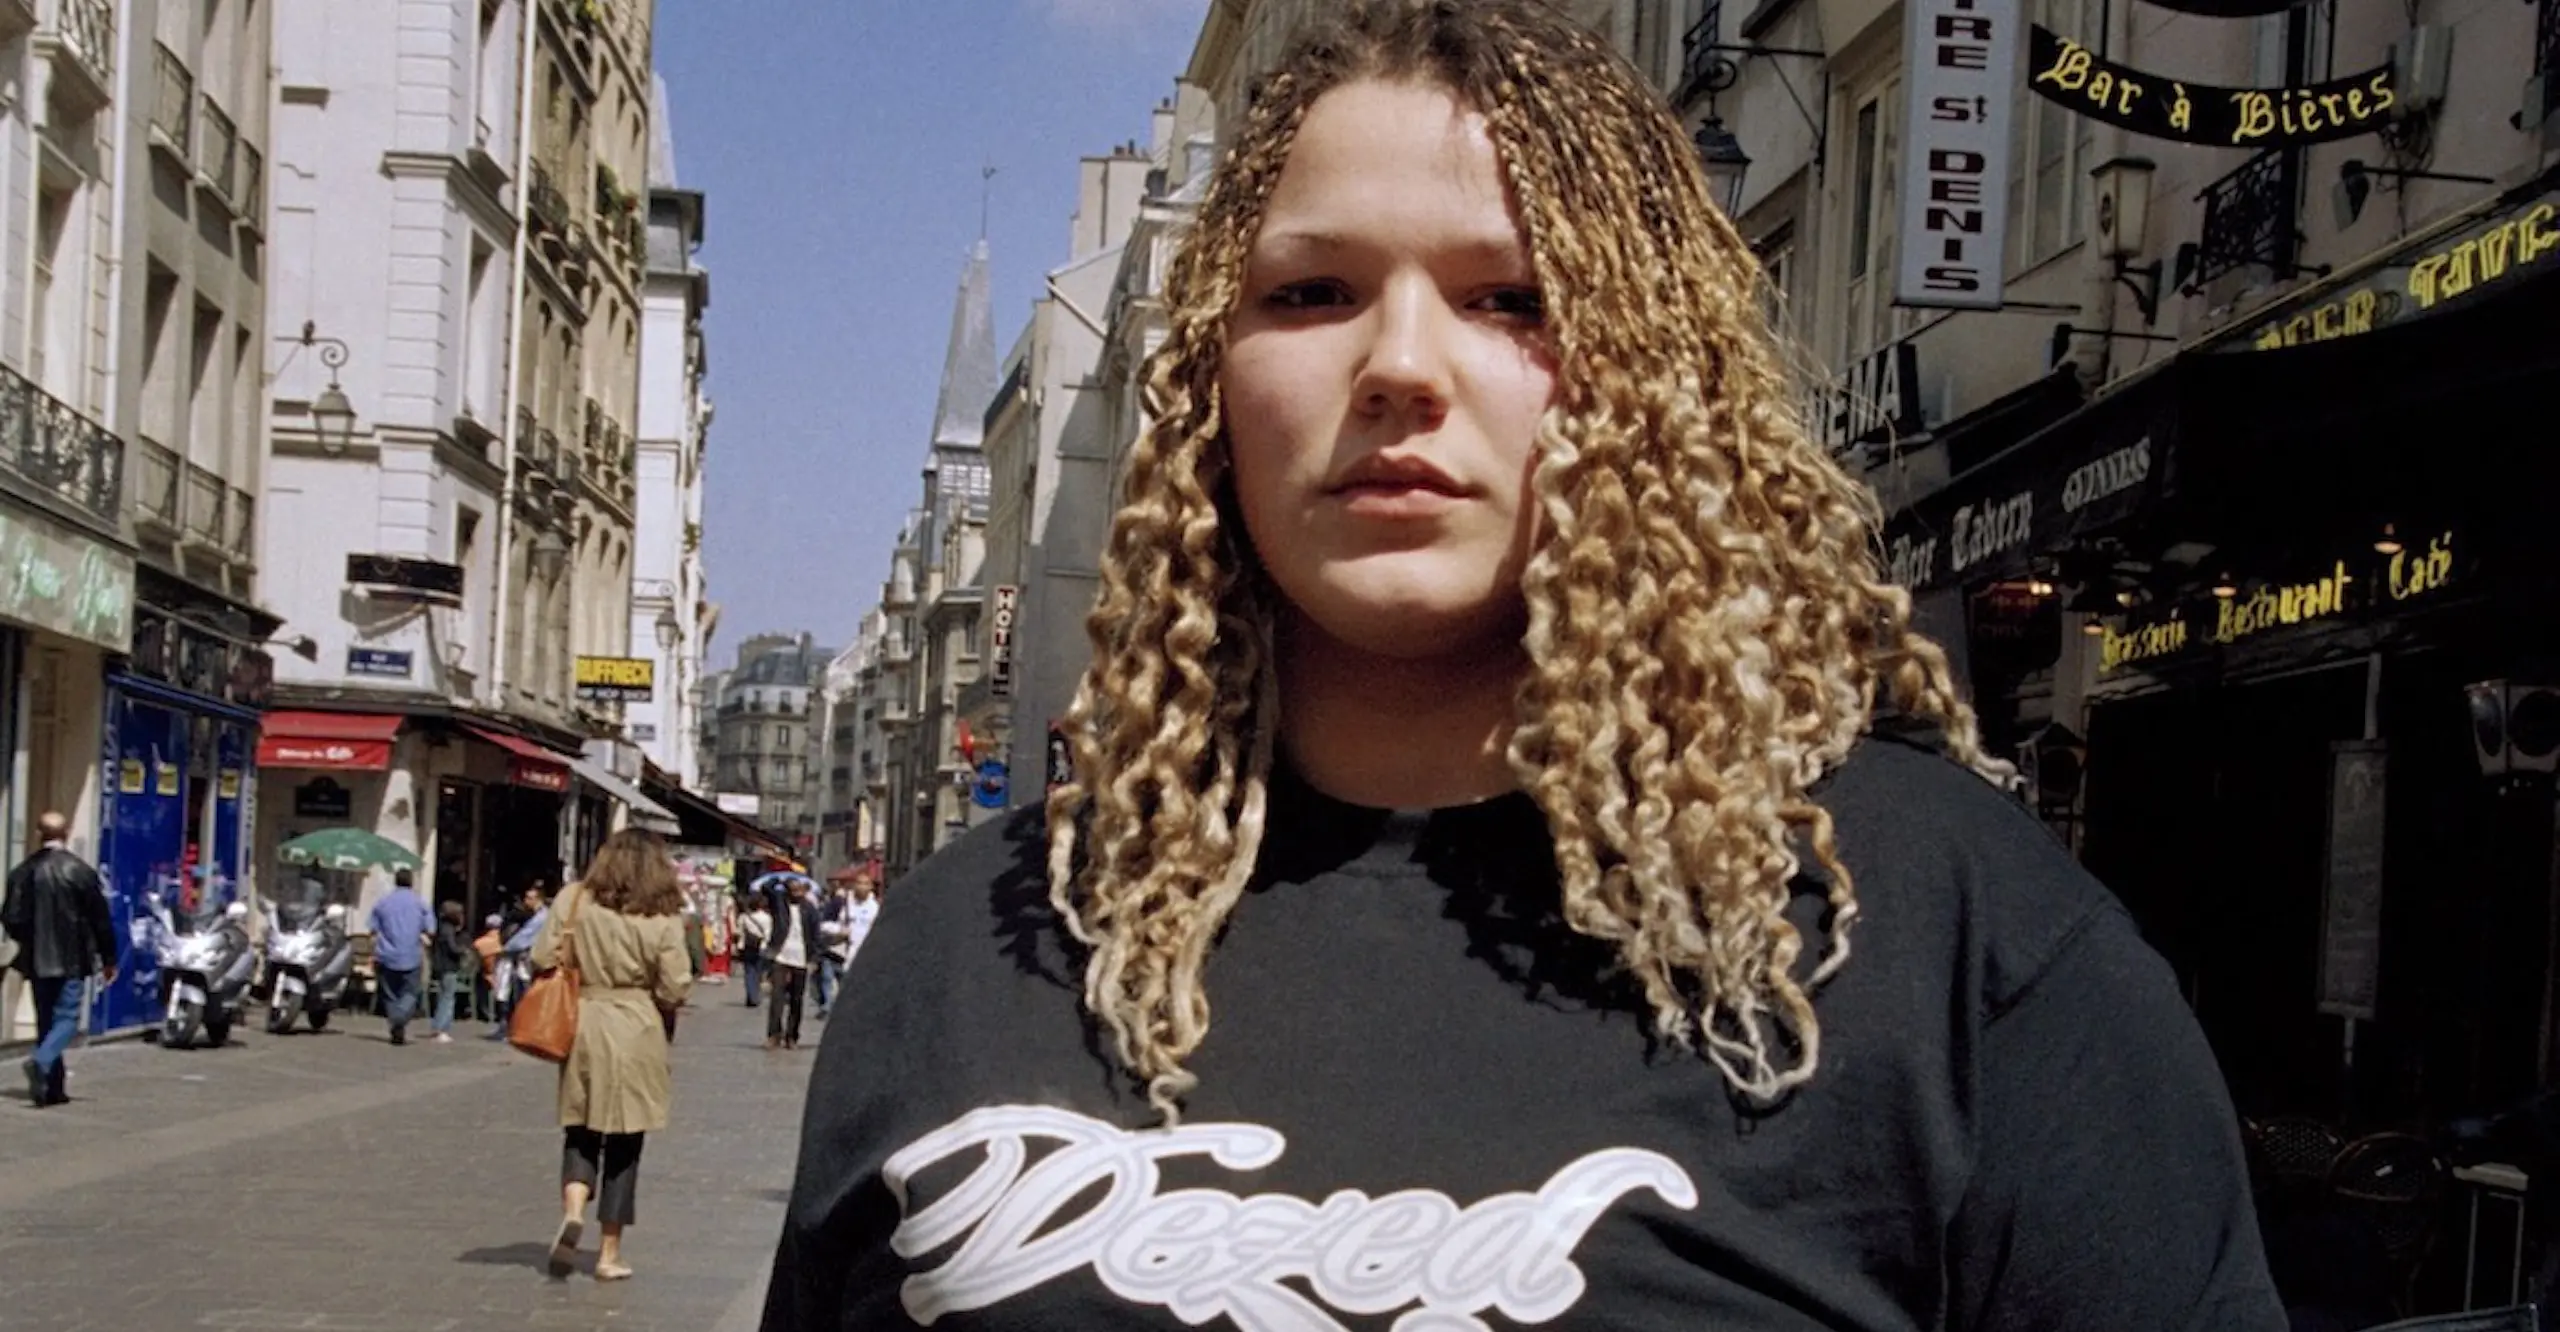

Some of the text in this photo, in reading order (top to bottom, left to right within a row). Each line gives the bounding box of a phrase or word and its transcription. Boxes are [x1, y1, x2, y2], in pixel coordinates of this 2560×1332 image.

[1936, 0, 1993, 70] RE
[2036, 36, 2394, 144] Bar à Bières
[1923, 149, 1985, 292] DENIS
[2388, 530, 2454, 601] Café
[992, 588, 1015, 684] HOTEL
[882, 1103, 1698, 1332] Dezed
